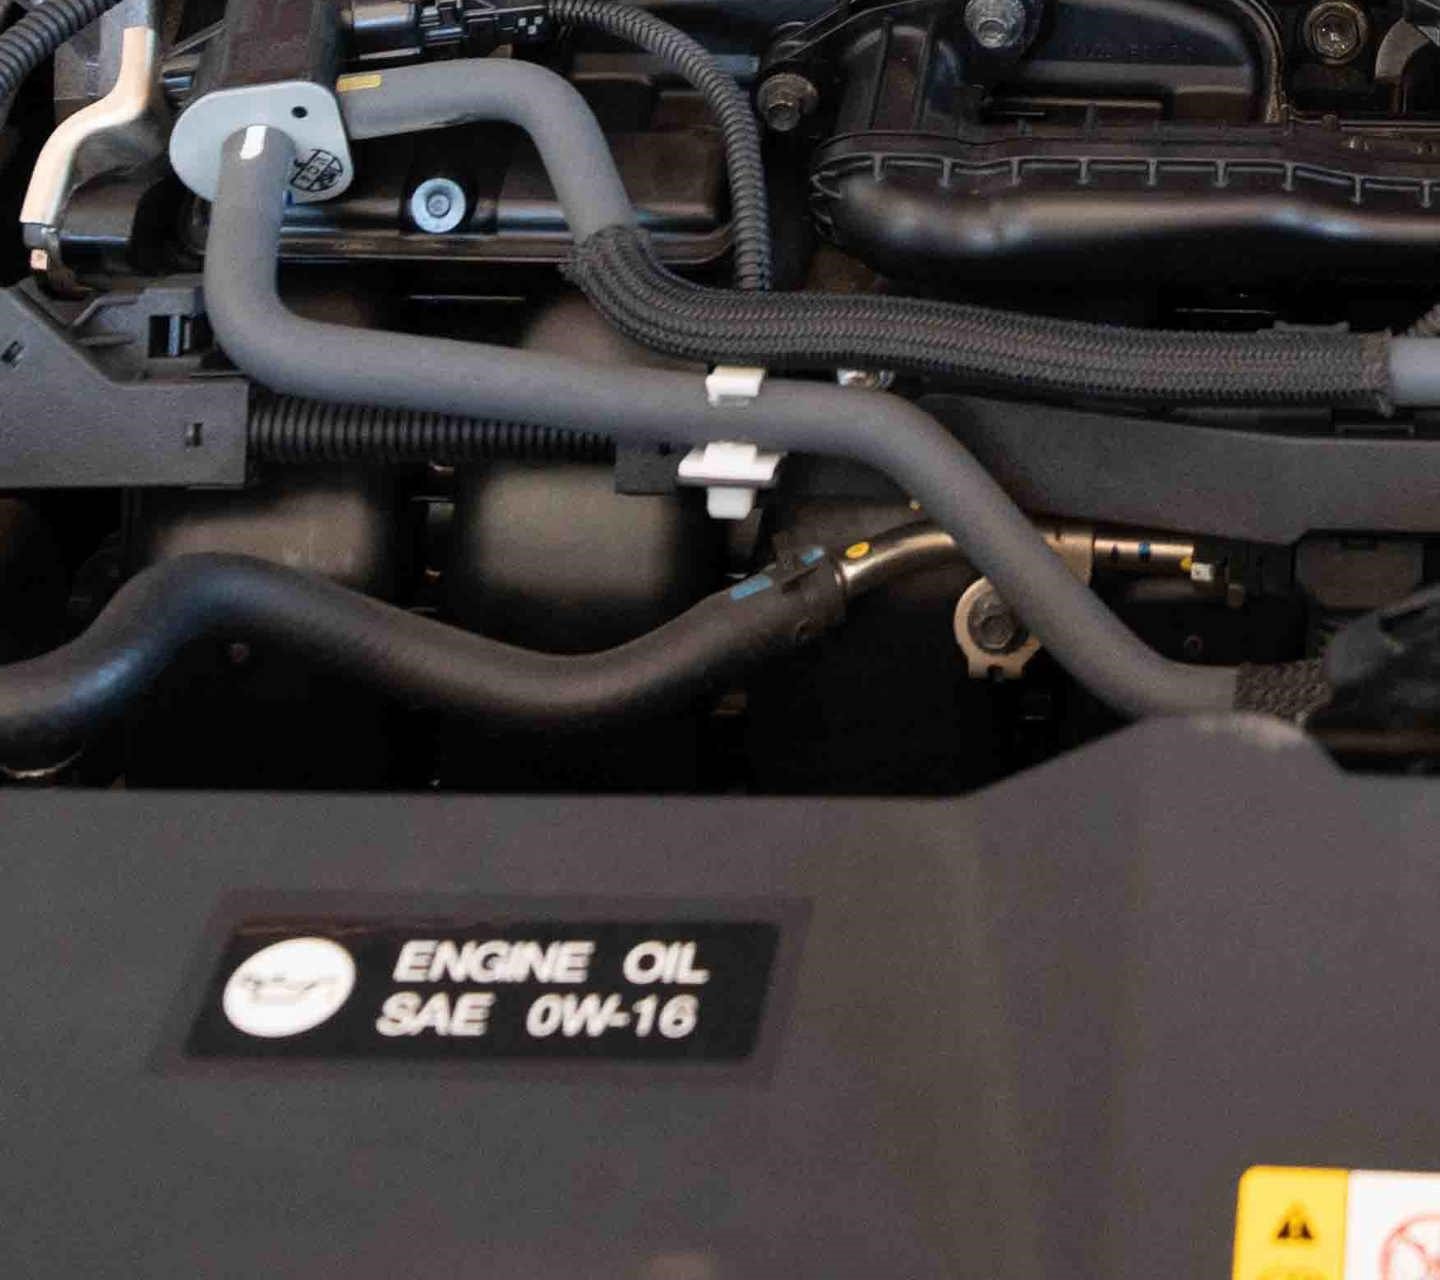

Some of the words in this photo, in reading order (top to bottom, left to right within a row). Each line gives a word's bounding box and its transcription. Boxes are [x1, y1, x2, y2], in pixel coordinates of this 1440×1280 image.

[393, 939, 595, 983] ENGINE
[622, 939, 710, 984] OIL
[375, 992, 497, 1037] SAE
[525, 993, 700, 1039] 0W-16
